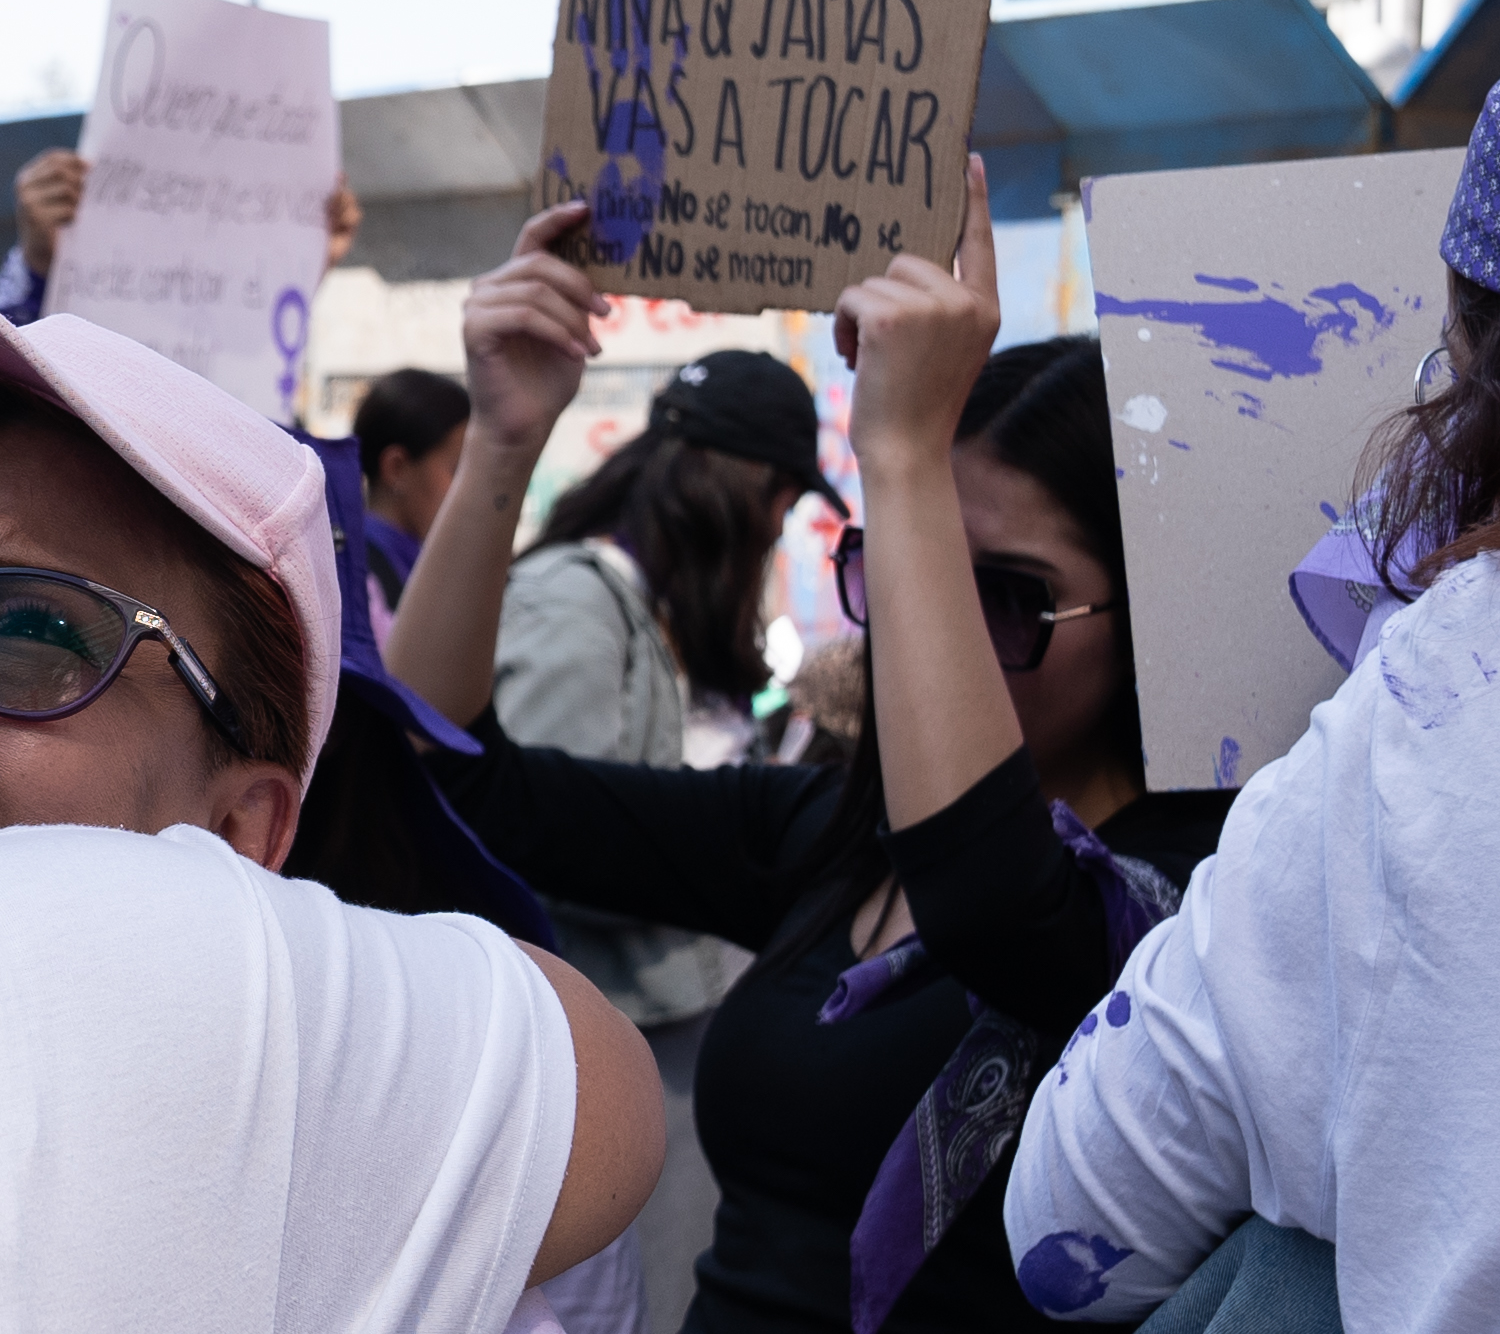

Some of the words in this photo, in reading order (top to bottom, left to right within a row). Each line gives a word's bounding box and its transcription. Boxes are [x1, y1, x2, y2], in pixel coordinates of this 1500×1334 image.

[588, 63, 695, 156] VAS
[712, 78, 747, 169] A
[768, 72, 940, 210] TOCAR
[658, 178, 698, 225] No
[704, 191, 731, 231] se
[877, 219, 904, 253] se
[694, 243, 720, 283] se
[728, 249, 813, 289] matan
